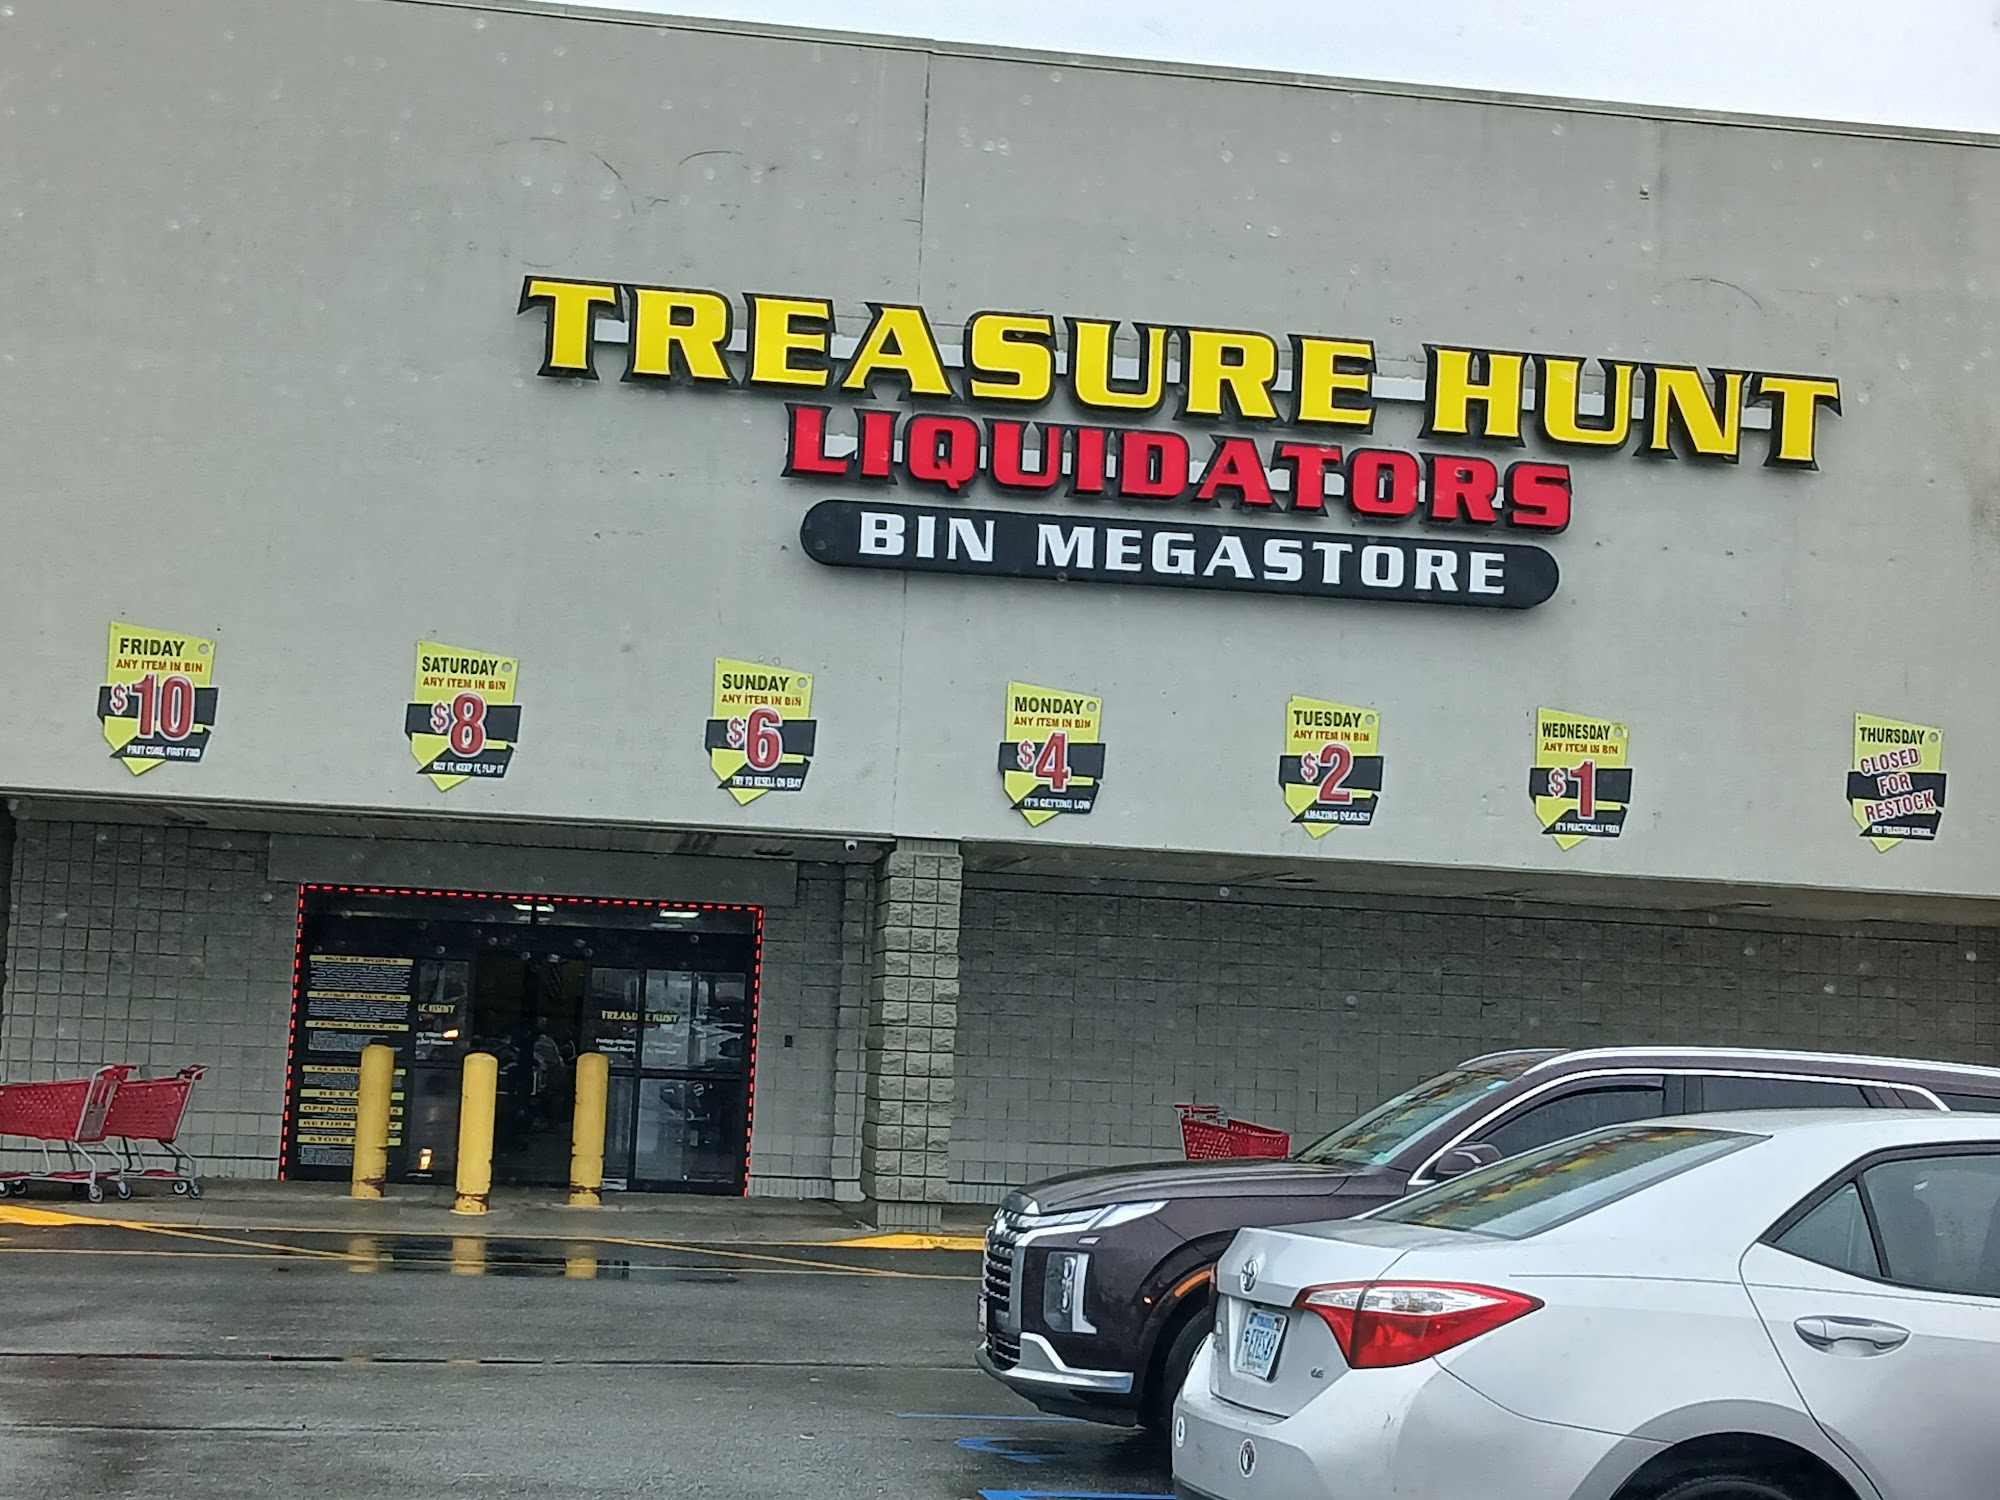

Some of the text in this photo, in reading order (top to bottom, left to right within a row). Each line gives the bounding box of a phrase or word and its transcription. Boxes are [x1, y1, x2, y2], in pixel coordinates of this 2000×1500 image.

[520, 276, 1842, 470] TREASURE HUNT
[783, 403, 1573, 533] LIQUIDATORS
[857, 510, 1506, 595] BIN MEGASTORE
[119, 637, 185, 657] FRIDAY
[116, 658, 203, 673] ANY ITEM IN BIN
[421, 656, 499, 676] SATURDAY
[422, 676, 506, 690] ANY ITEM IN BIN
[722, 673, 790, 692] SUNDAY
[112, 674, 193, 739] $10
[721, 693, 802, 707] ANY ITEM IN BIN
[1014, 696, 1085, 715] MONDAY
[433, 693, 484, 755] $8
[1013, 716, 1091, 729] ANY ITEM IN BIN
[1293, 709, 1362, 728] TUESDAY
[729, 708, 780, 769] $6
[1293, 730, 1370, 742] ANY ITEM IN BIN
[1542, 722, 1611, 741] WEDNESDAY
[1859, 727, 1925, 745] THURSDAY
[1543, 742, 1618, 754] ANY ITEM IN BIN
[1019, 732, 1069, 789] $4
[1859, 748, 1920, 775] CLOSED
[1303, 744, 1351, 802] $2
[1550, 761, 1593, 817] $1
[1878, 773, 1911, 795] FOR
[1864, 791, 1935, 823] RESTOCK
[601, 1010, 651, 1022] TREASUE
